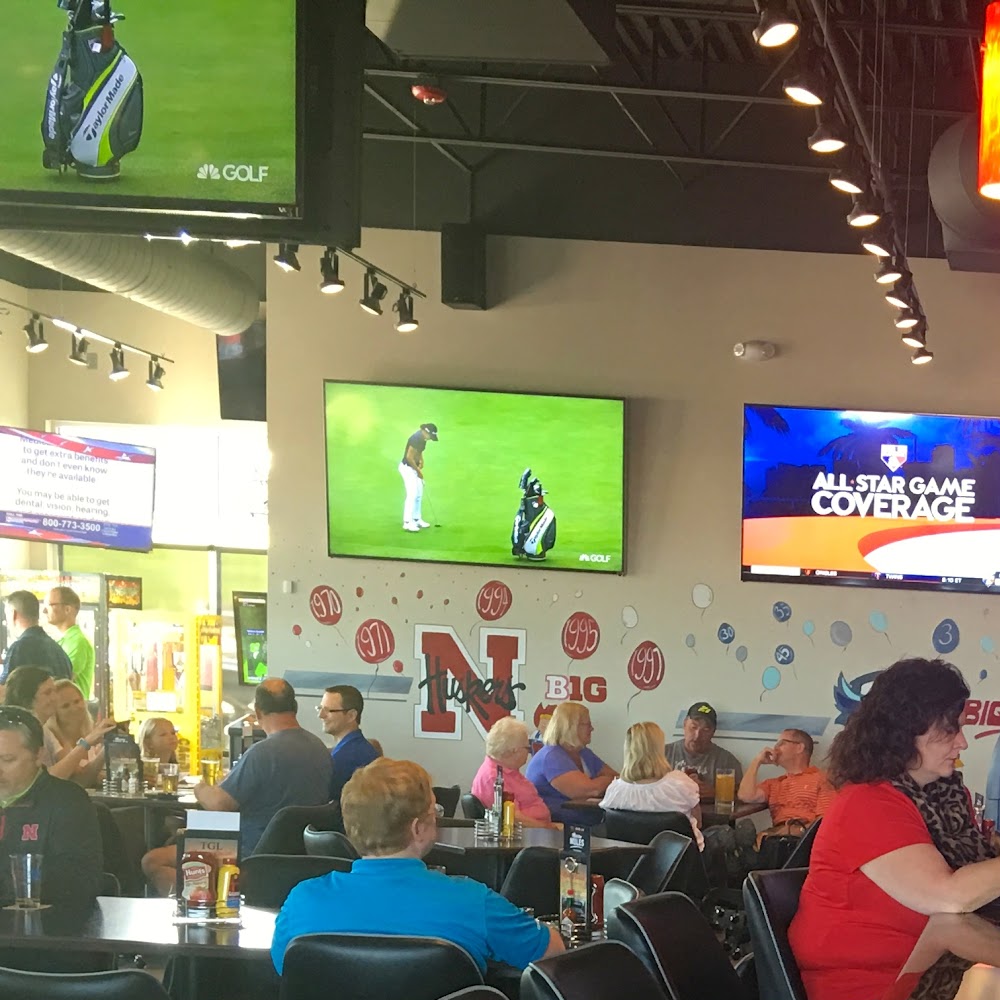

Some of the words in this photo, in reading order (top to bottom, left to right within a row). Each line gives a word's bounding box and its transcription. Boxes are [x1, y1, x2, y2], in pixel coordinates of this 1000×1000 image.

[83, 74, 124, 141] TaylorMade
[222, 164, 269, 182] GOLF
[23, 446, 32, 454] to
[34, 448, 48, 456] get
[50, 449, 72, 459] extra
[21, 457, 38, 465] and
[39, 458, 60, 468] dont
[62, 462, 83, 471] even
[84, 464, 108, 474] know
[26, 467, 57, 478] theyre
[812, 471, 853, 491] ALL
[855, 474, 906, 494] STAR
[909, 477, 976, 497] GAME
[17, 488, 33, 497] You
[34, 490, 52, 500] may
[54, 492, 65, 500] be
[66, 493, 84, 502] able
[86, 496, 95, 504] to
[97, 498, 110, 506] get
[811, 490, 976, 523] COVERAGE
[42, 518, 101, 531] 800-773-3500
[590, 554, 611, 562] GOLF
[357, 622, 391, 657] 1971
[564, 618, 599, 654] 1995
[720, 626, 734, 640] 30
[938, 623, 953, 645] 3
[631, 646, 662, 684] 1997
[21, 823, 39, 841] N
[200, 841, 224, 851] TGL
